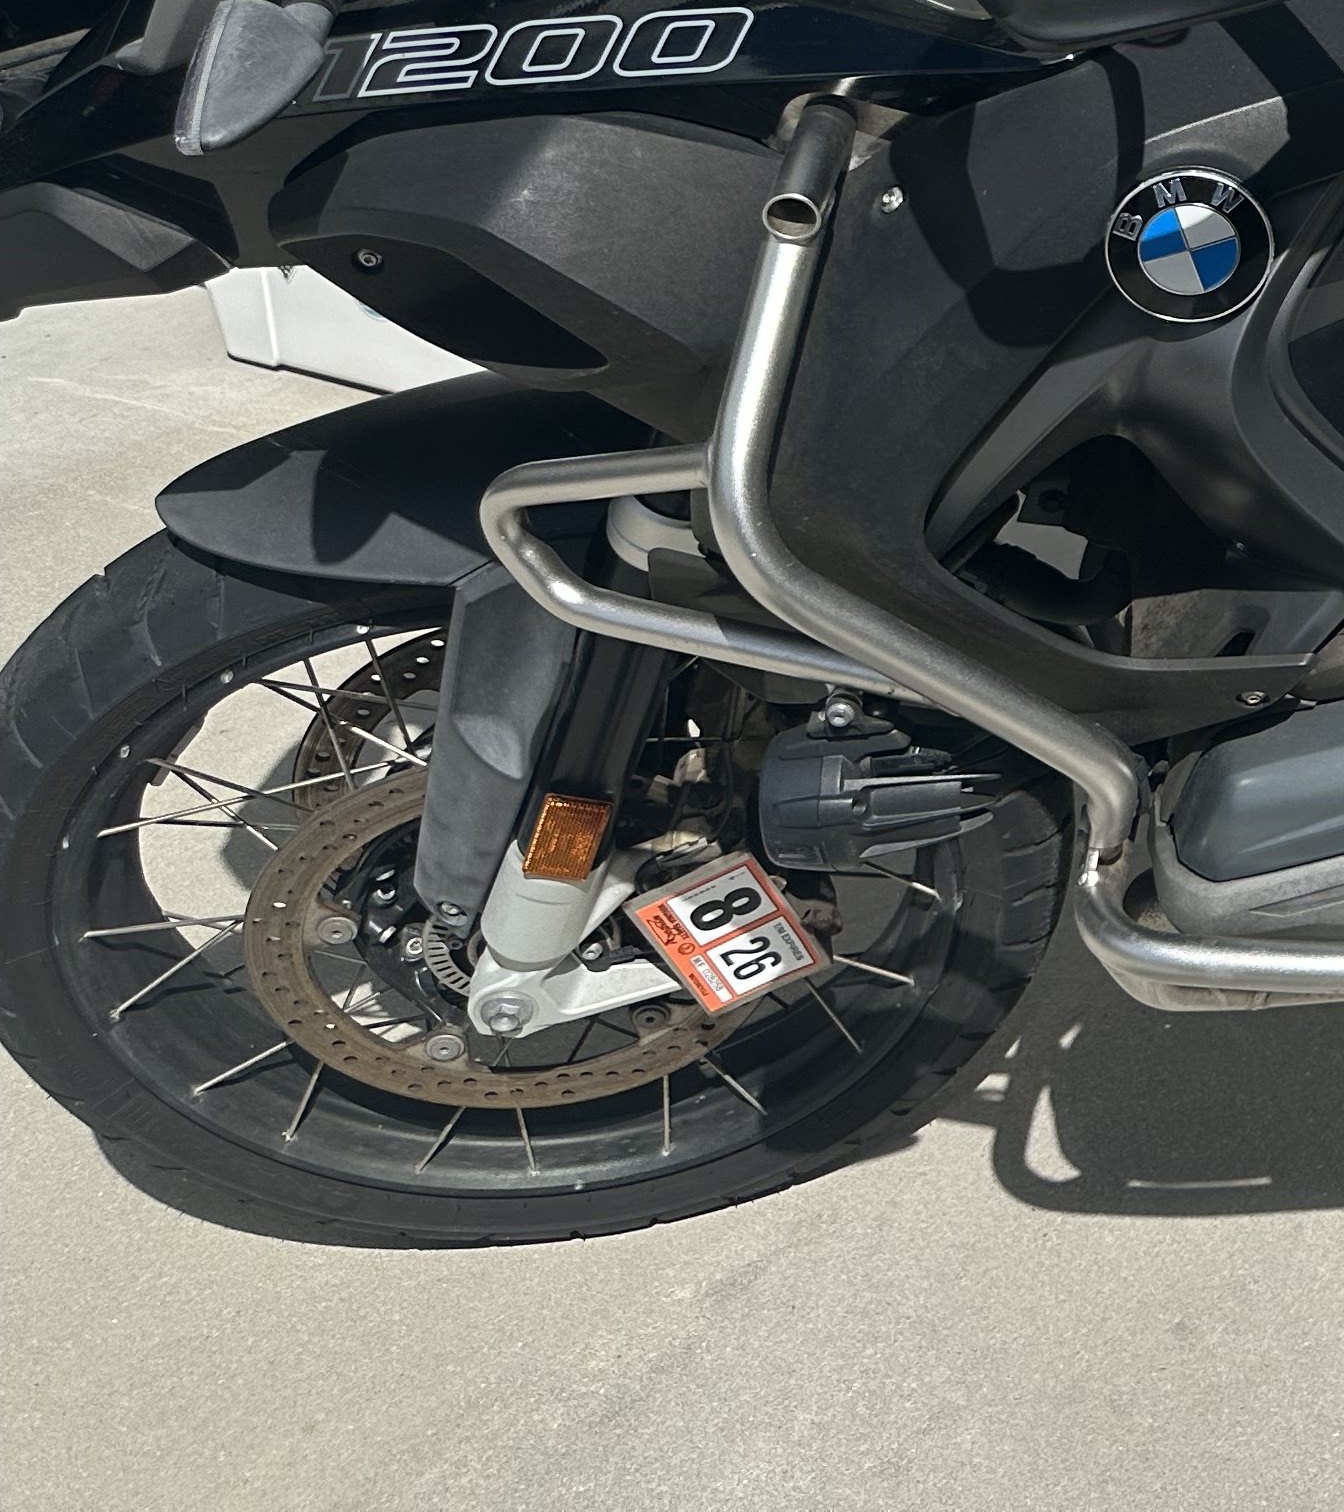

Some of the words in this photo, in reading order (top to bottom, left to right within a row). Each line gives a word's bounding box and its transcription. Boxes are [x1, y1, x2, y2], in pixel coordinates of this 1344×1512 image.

[312, 5, 756, 102] 1200
[1112, 177, 1245, 242] BMW
[689, 886, 762, 932] 8
[719, 935, 783, 981] 26
